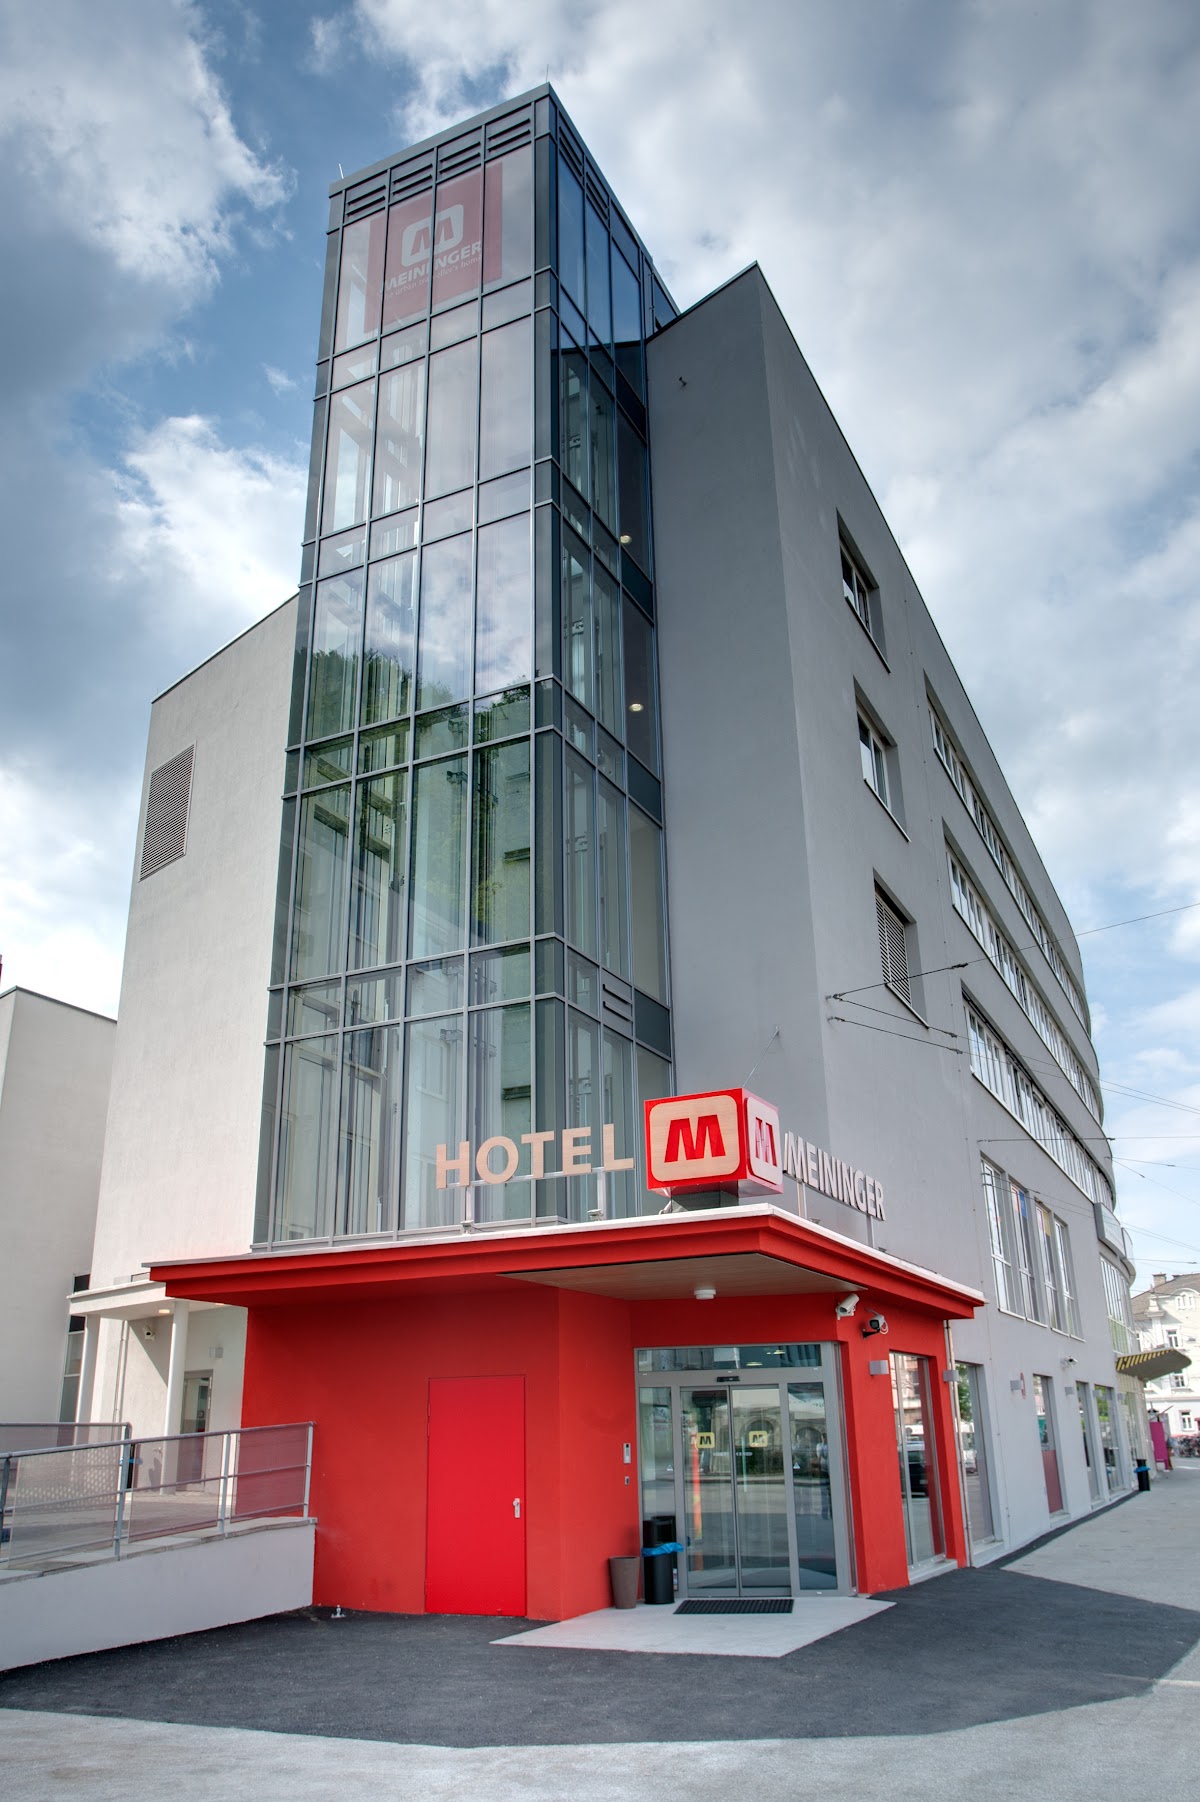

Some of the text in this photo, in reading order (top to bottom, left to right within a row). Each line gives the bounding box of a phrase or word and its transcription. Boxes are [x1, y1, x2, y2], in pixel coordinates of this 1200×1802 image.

[396, 283, 417, 296] urban
[436, 1123, 634, 1189] HOTEL
[664, 1114, 726, 1163] M
[783, 1131, 886, 1221] MEININGER
[700, 1436, 712, 1445] M
